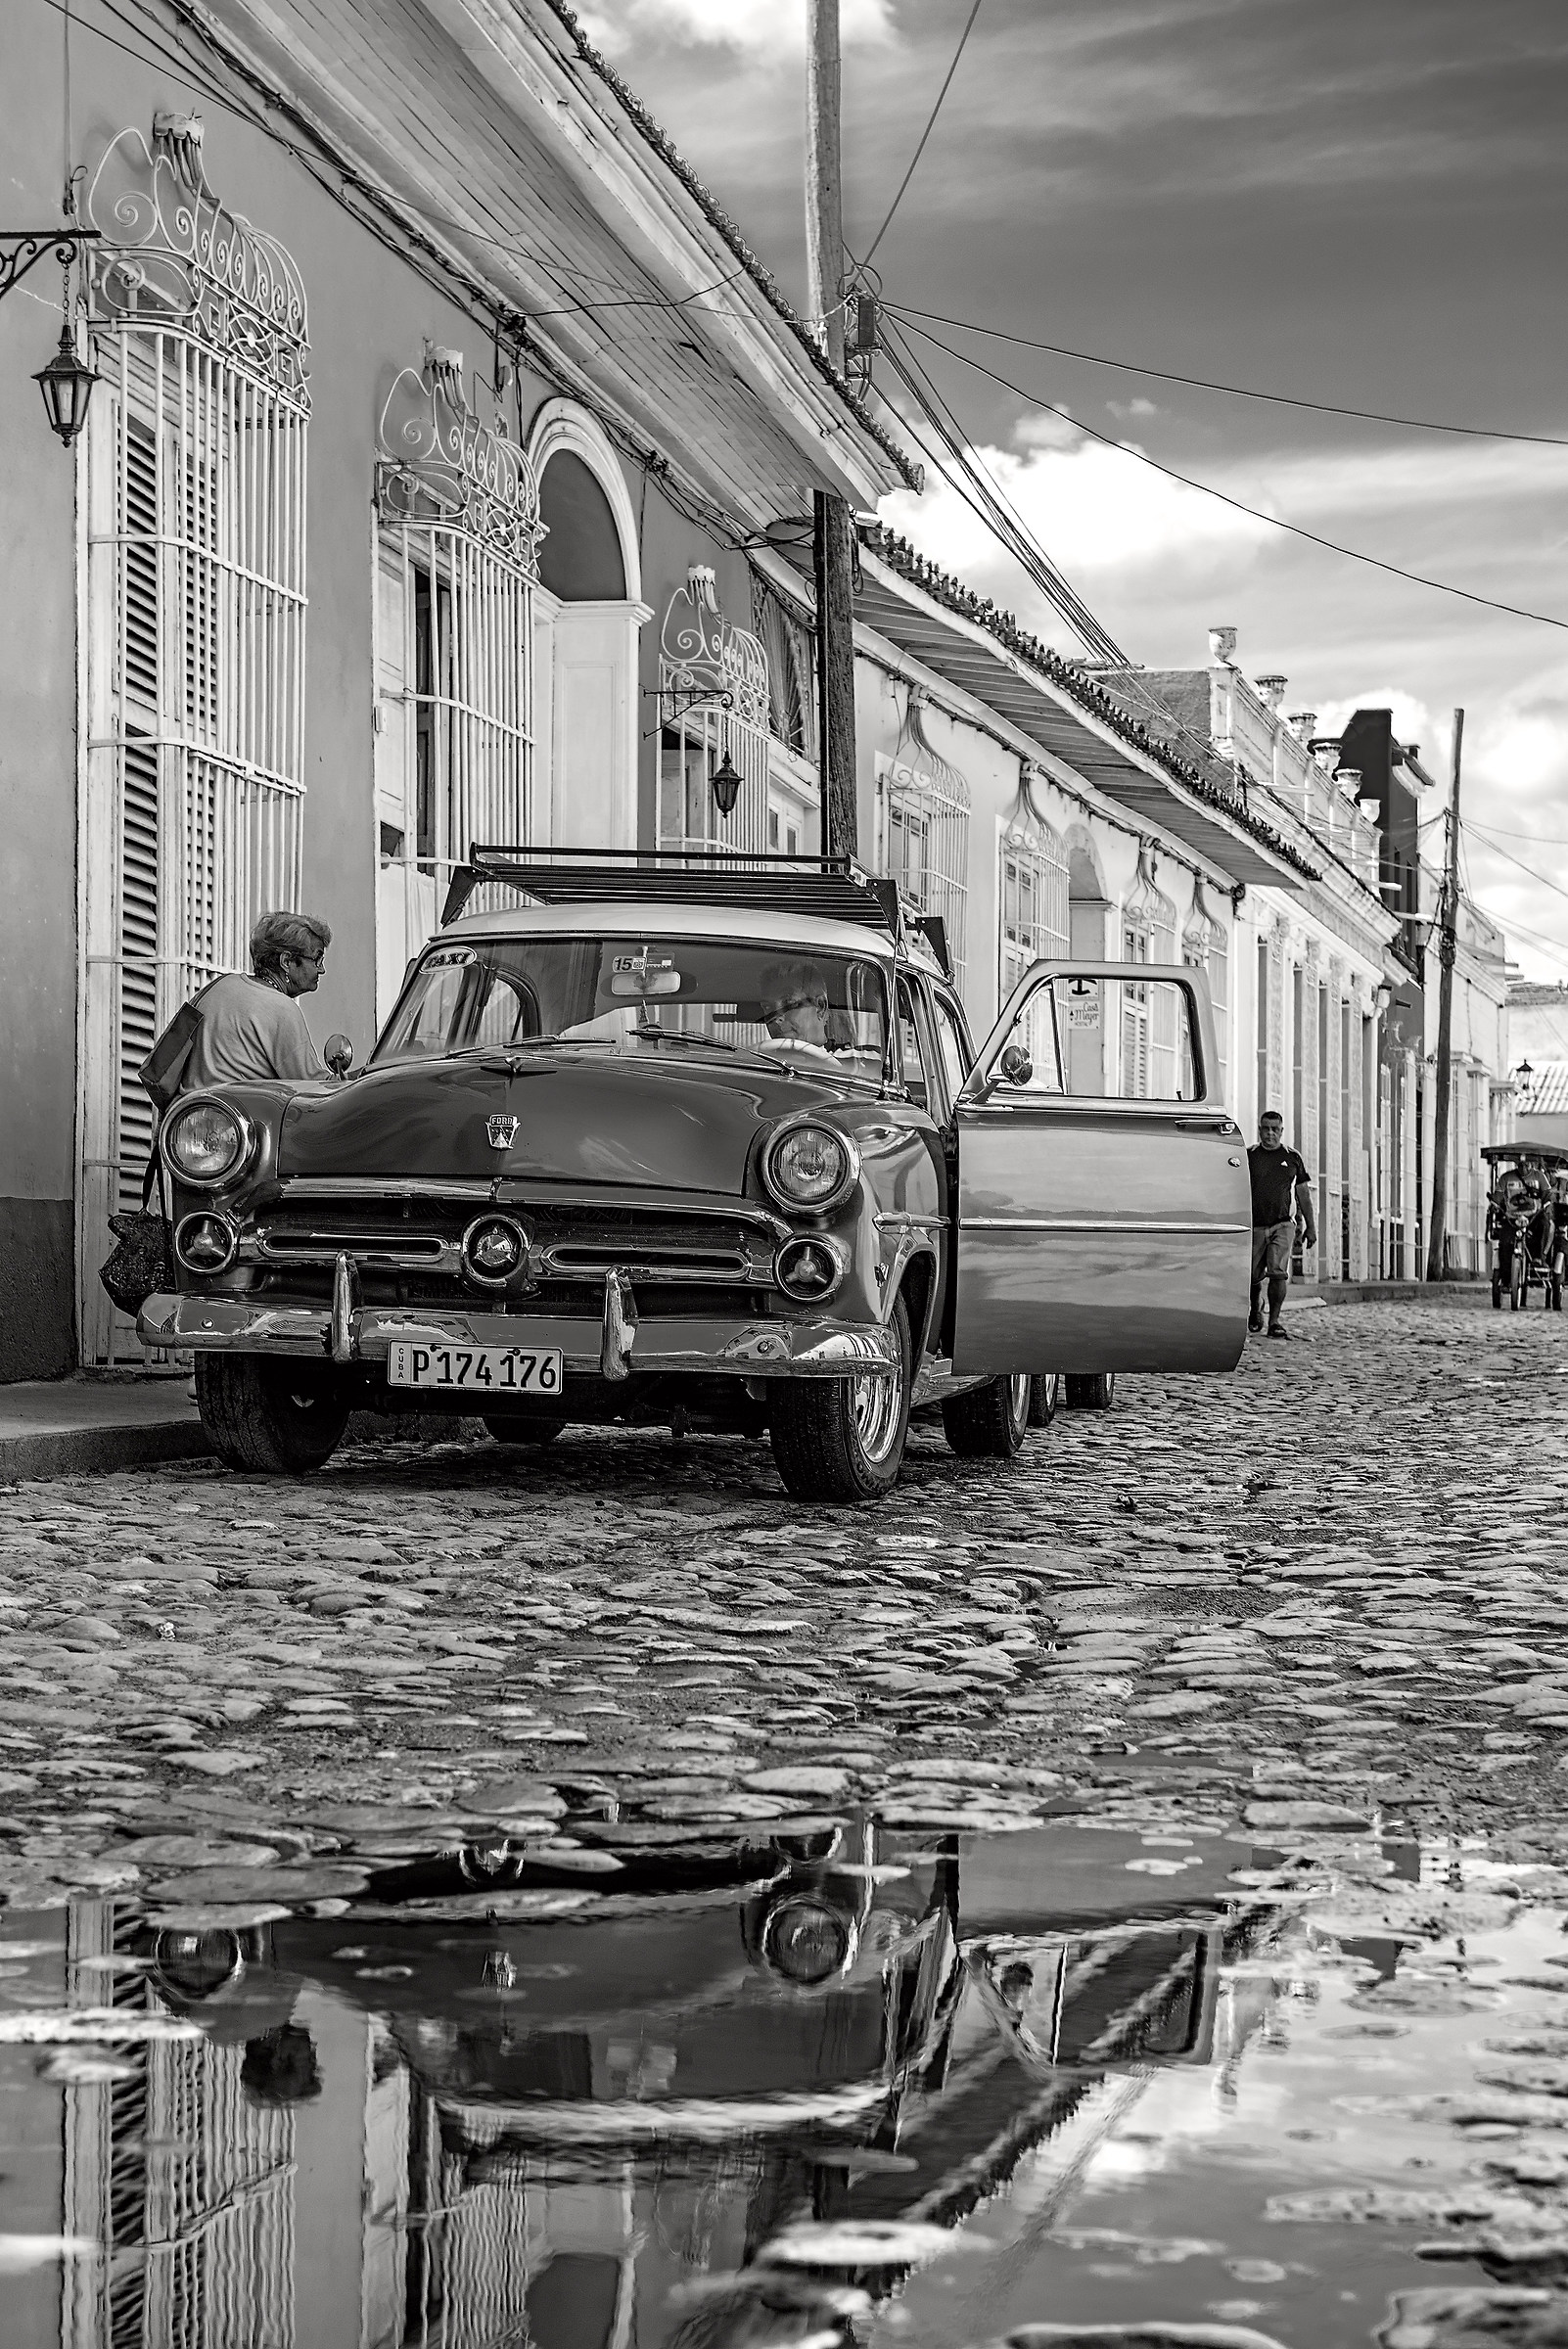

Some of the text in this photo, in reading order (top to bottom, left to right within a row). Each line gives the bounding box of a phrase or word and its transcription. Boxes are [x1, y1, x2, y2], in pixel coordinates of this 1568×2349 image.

[425, 951, 473, 970] TAXI
[614, 958, 632, 971] 15
[491, 1117, 513, 1126] FORD
